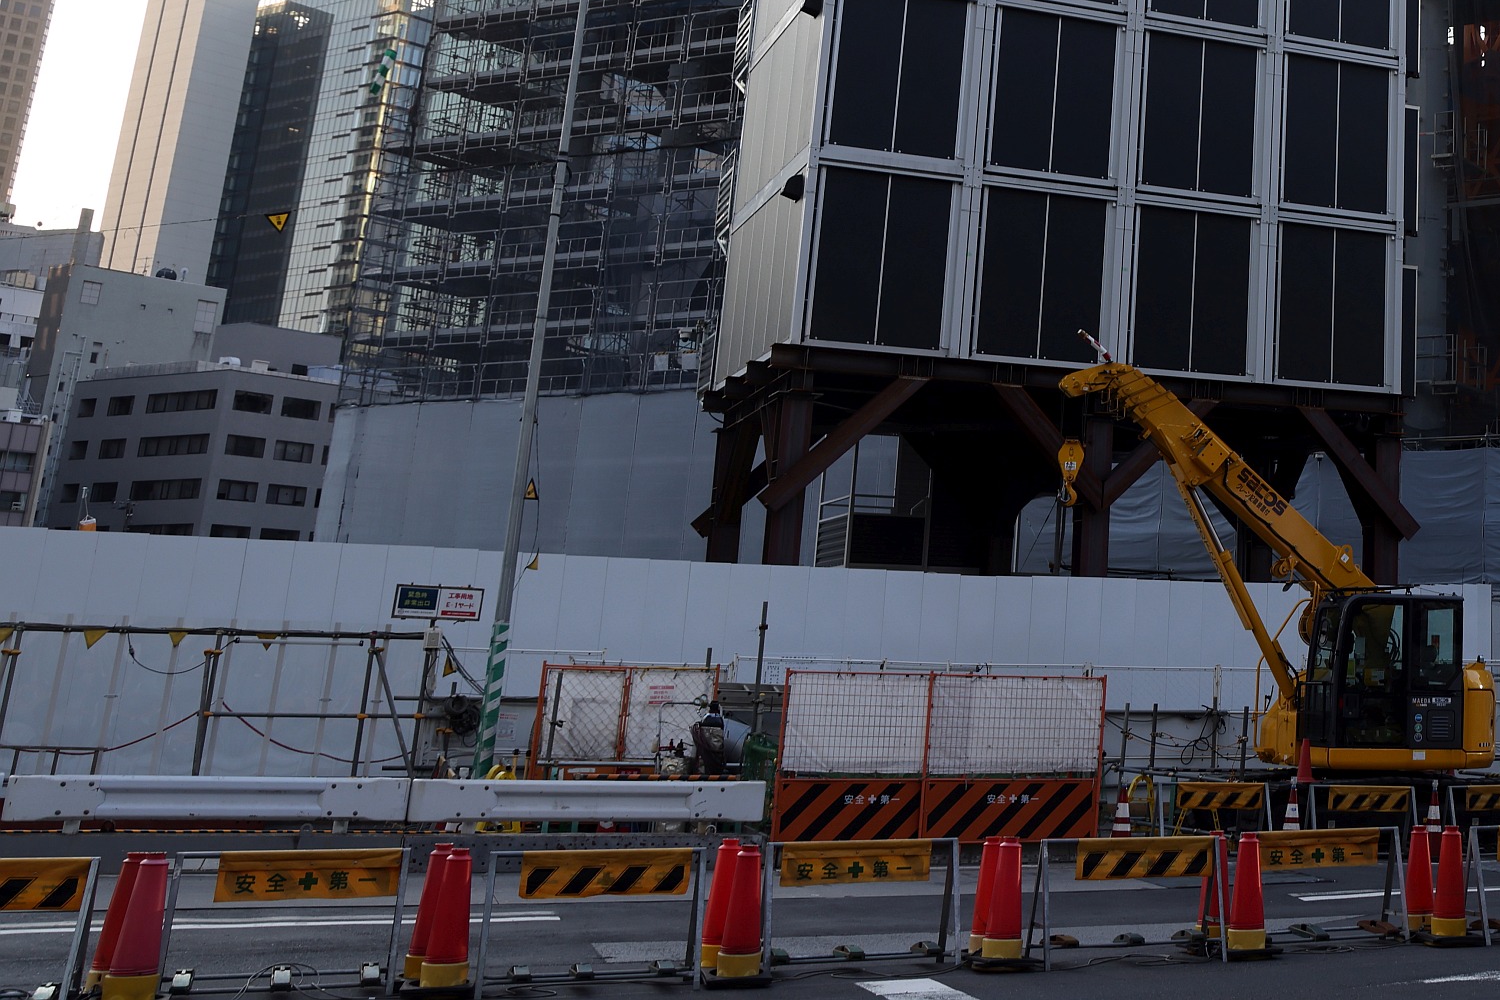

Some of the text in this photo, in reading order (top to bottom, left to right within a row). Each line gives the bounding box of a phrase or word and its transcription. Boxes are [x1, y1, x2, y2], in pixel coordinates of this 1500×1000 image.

[843, 794, 901, 805] 安全 第一
[986, 794, 1040, 805] 安全 第一
[1269, 846, 1364, 866] 安全 第一
[796, 860, 912, 881] 安全 第一
[234, 870, 377, 894] 安全 第一
